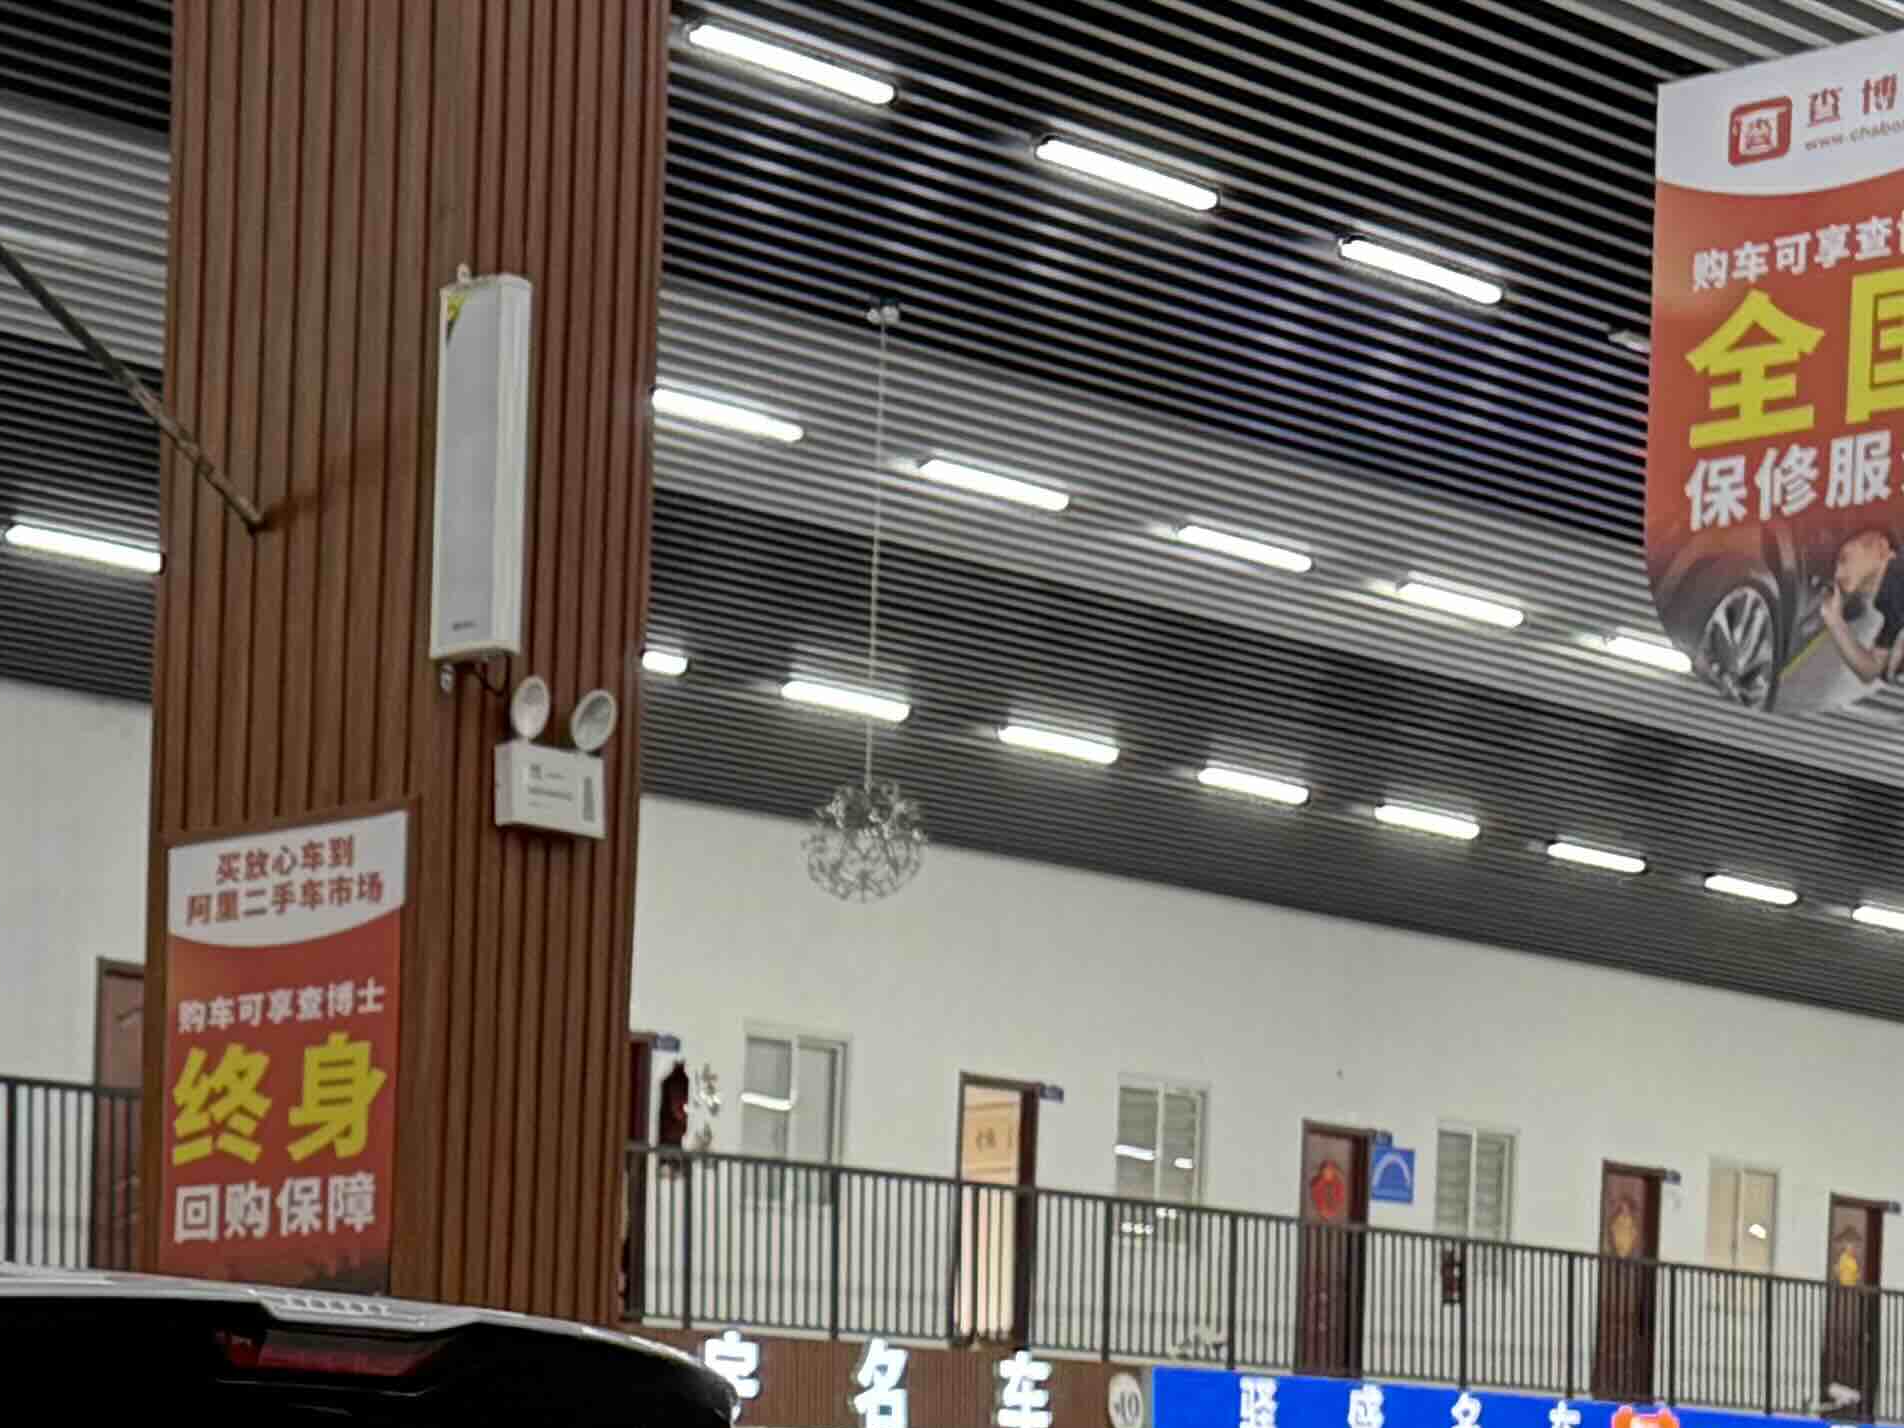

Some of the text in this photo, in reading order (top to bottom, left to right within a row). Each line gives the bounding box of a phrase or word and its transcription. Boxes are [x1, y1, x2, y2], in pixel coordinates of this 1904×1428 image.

[1694, 210, 1904, 292] 购车可享查
[1684, 427, 1904, 531] 保修服
[216, 834, 354, 885] 买放心车到
[186, 872, 384, 926] 阿里二手车市场
[178, 976, 384, 1033] 购车可享查博士
[172, 1031, 386, 1166] 终身
[174, 1171, 377, 1242] 回购保障
